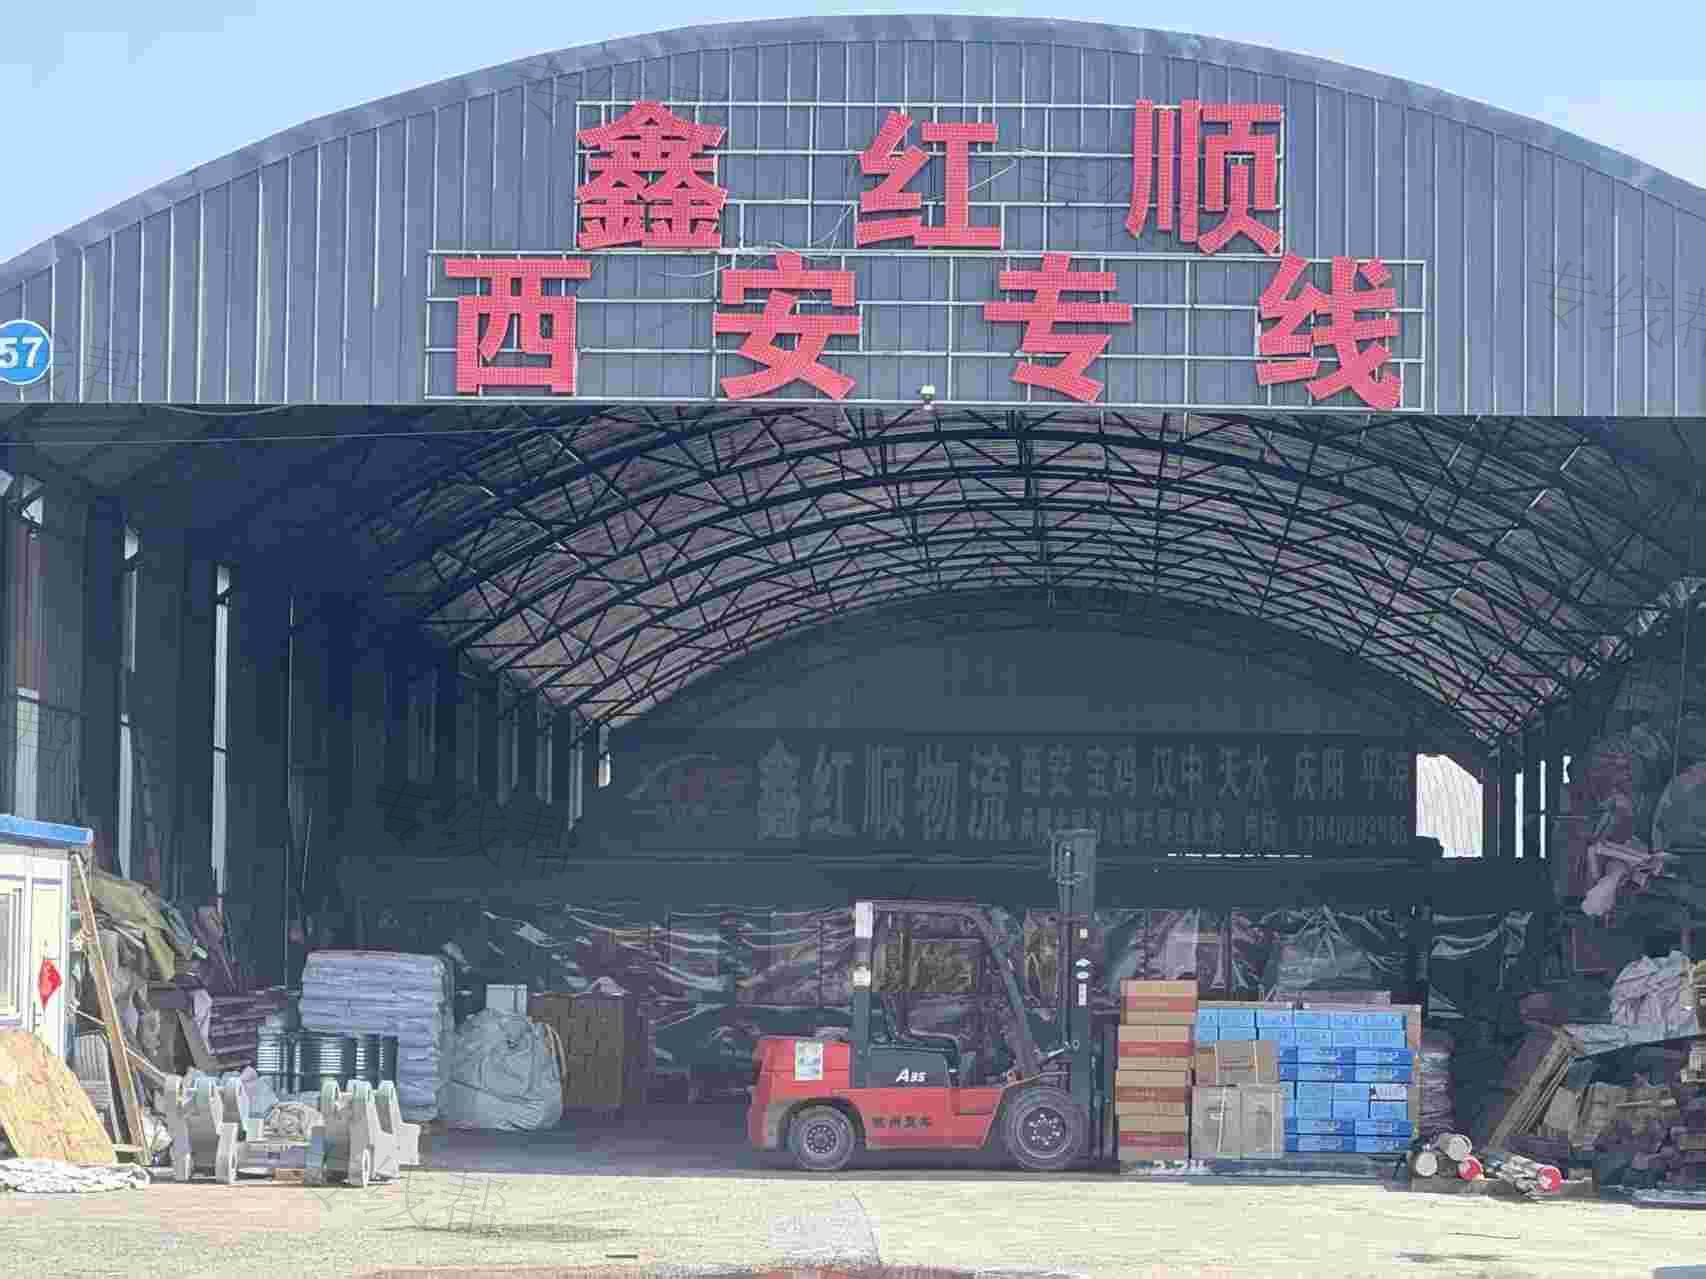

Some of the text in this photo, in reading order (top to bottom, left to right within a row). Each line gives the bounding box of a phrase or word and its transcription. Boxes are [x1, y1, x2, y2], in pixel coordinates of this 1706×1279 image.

[577, 99, 1284, 255] 鑫红顺
[445, 252, 1402, 410] 西安专线
[756, 737, 1012, 840] 鑫红顺物流
[1021, 743, 1073, 799] 西安
[1151, 743, 1205, 800] 汉中
[1215, 743, 1270, 800] 天水
